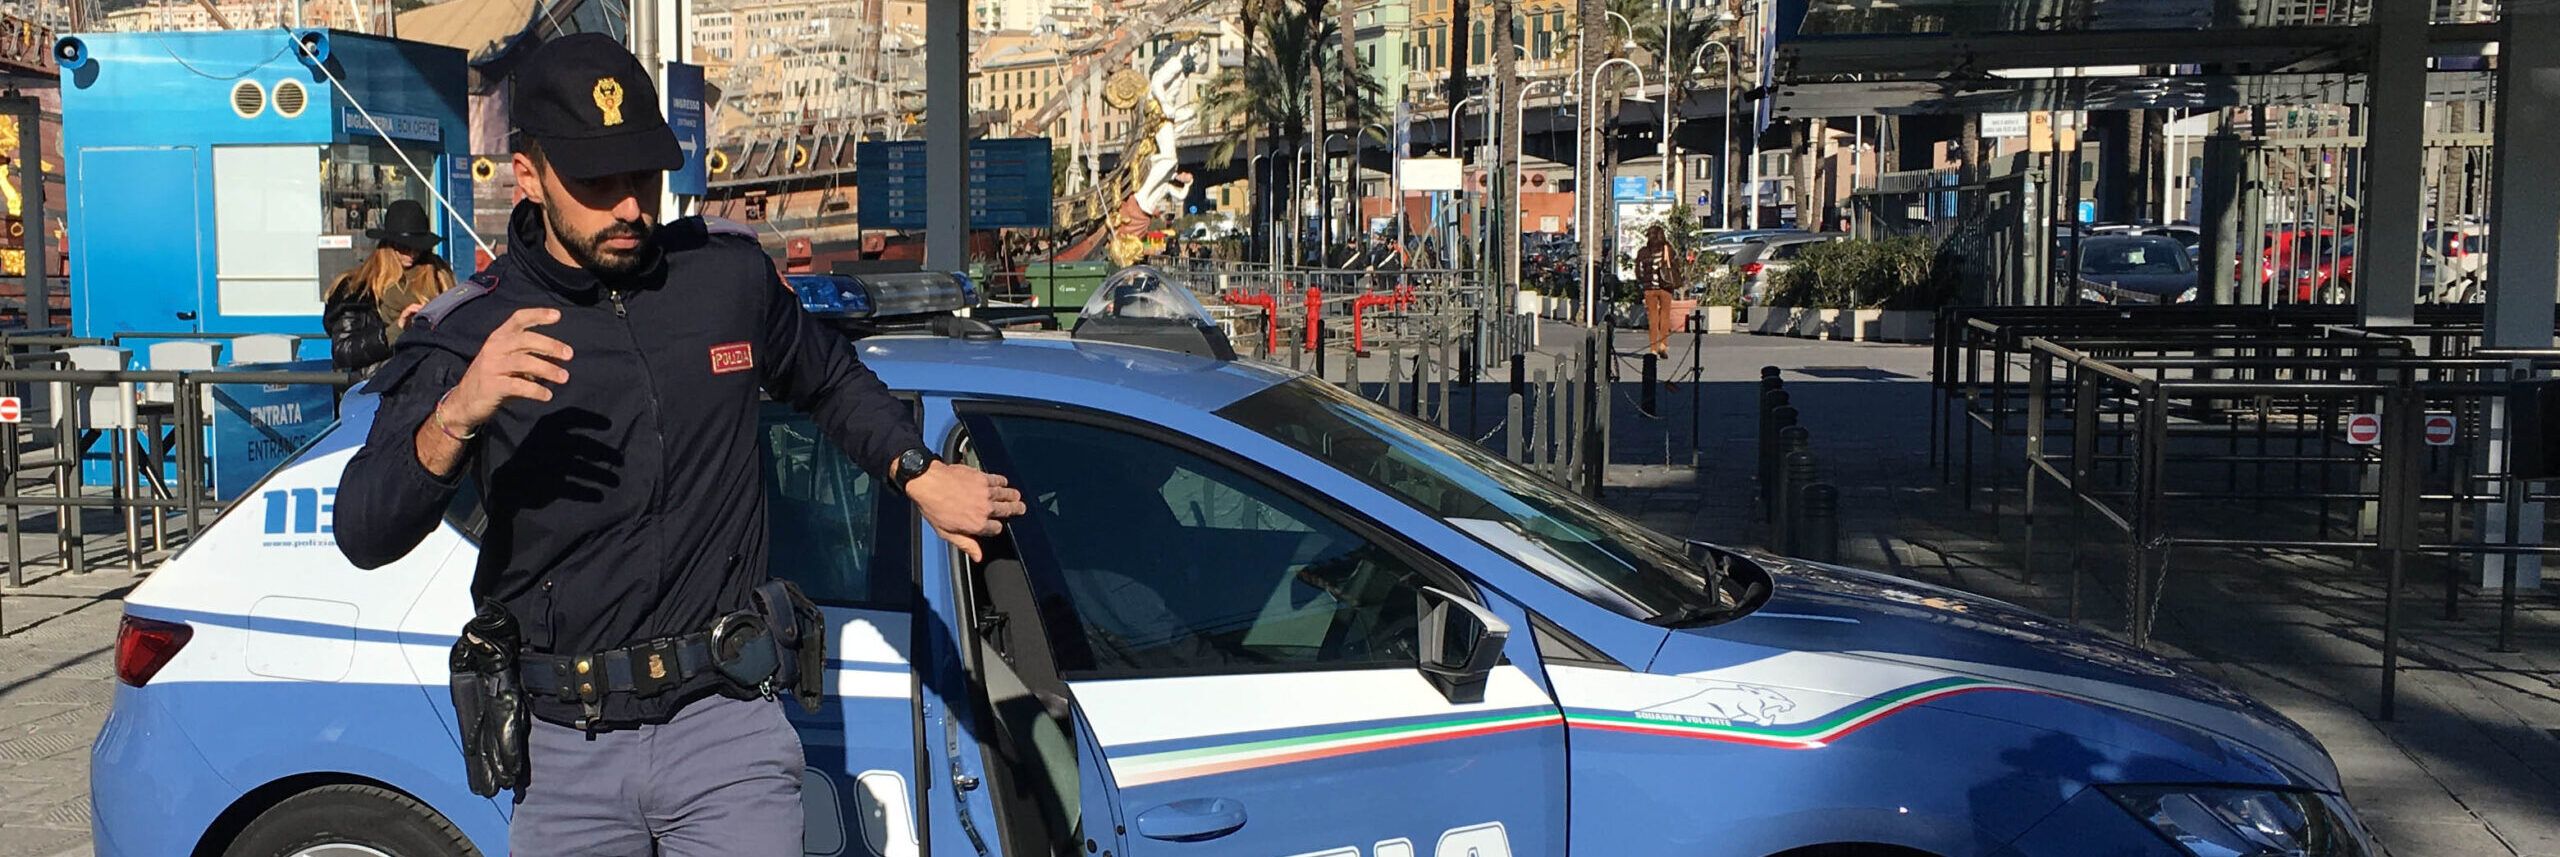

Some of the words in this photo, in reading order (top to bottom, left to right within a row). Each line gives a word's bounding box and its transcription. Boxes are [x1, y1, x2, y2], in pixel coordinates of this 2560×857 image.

[715, 350, 749, 367] POLIZIA
[250, 403, 303, 428] ENTRATA
[1634, 711, 1684, 722] SQUADRA
[1684, 715, 1733, 727] VOLANTE
